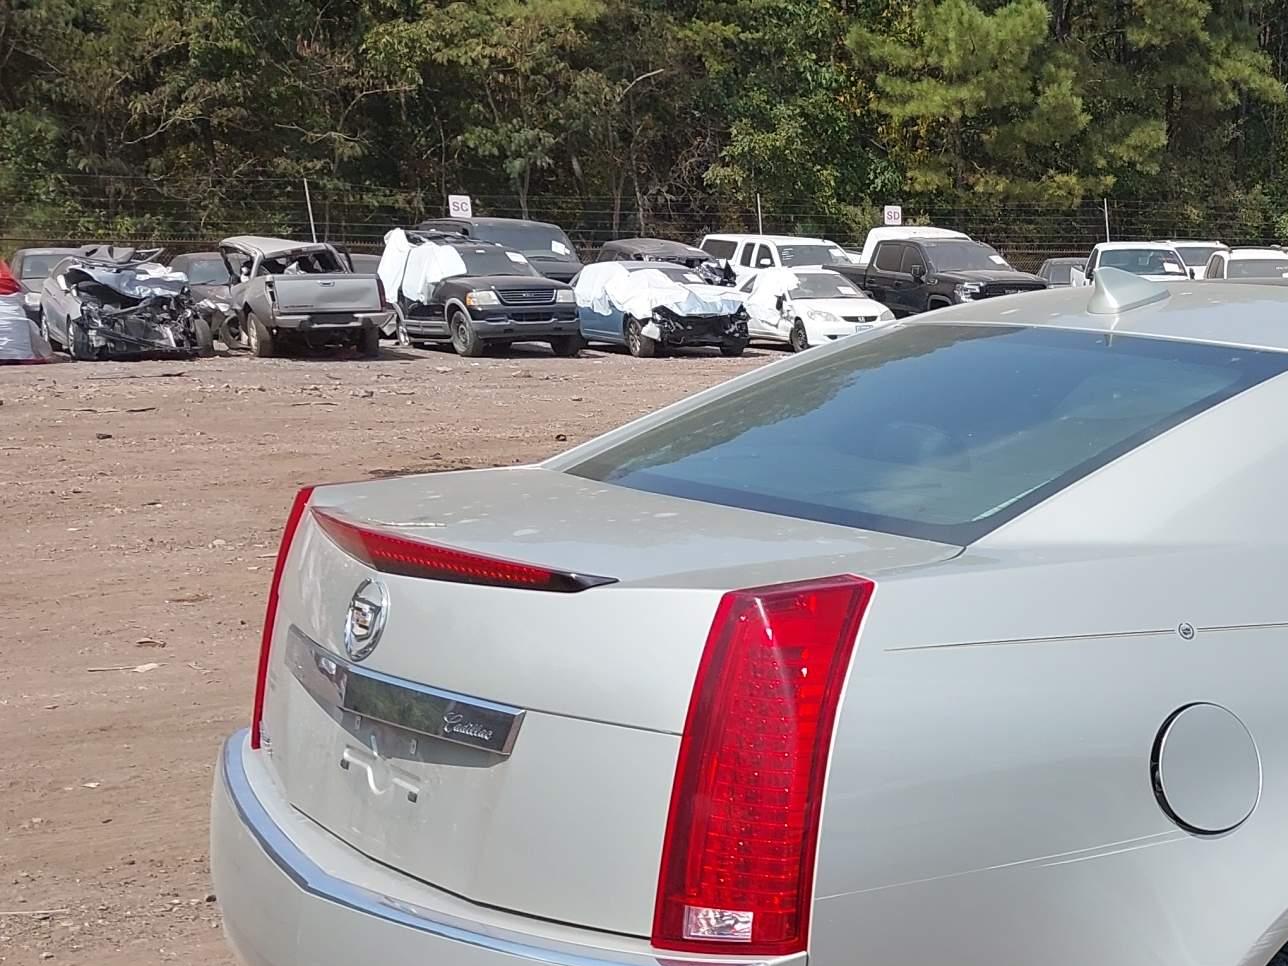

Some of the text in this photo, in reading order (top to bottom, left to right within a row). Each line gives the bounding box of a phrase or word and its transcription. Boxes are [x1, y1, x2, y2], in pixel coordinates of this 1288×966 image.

[452, 201, 469, 212] SC
[886, 210, 900, 221] SD
[443, 711, 494, 741] Cadillac
